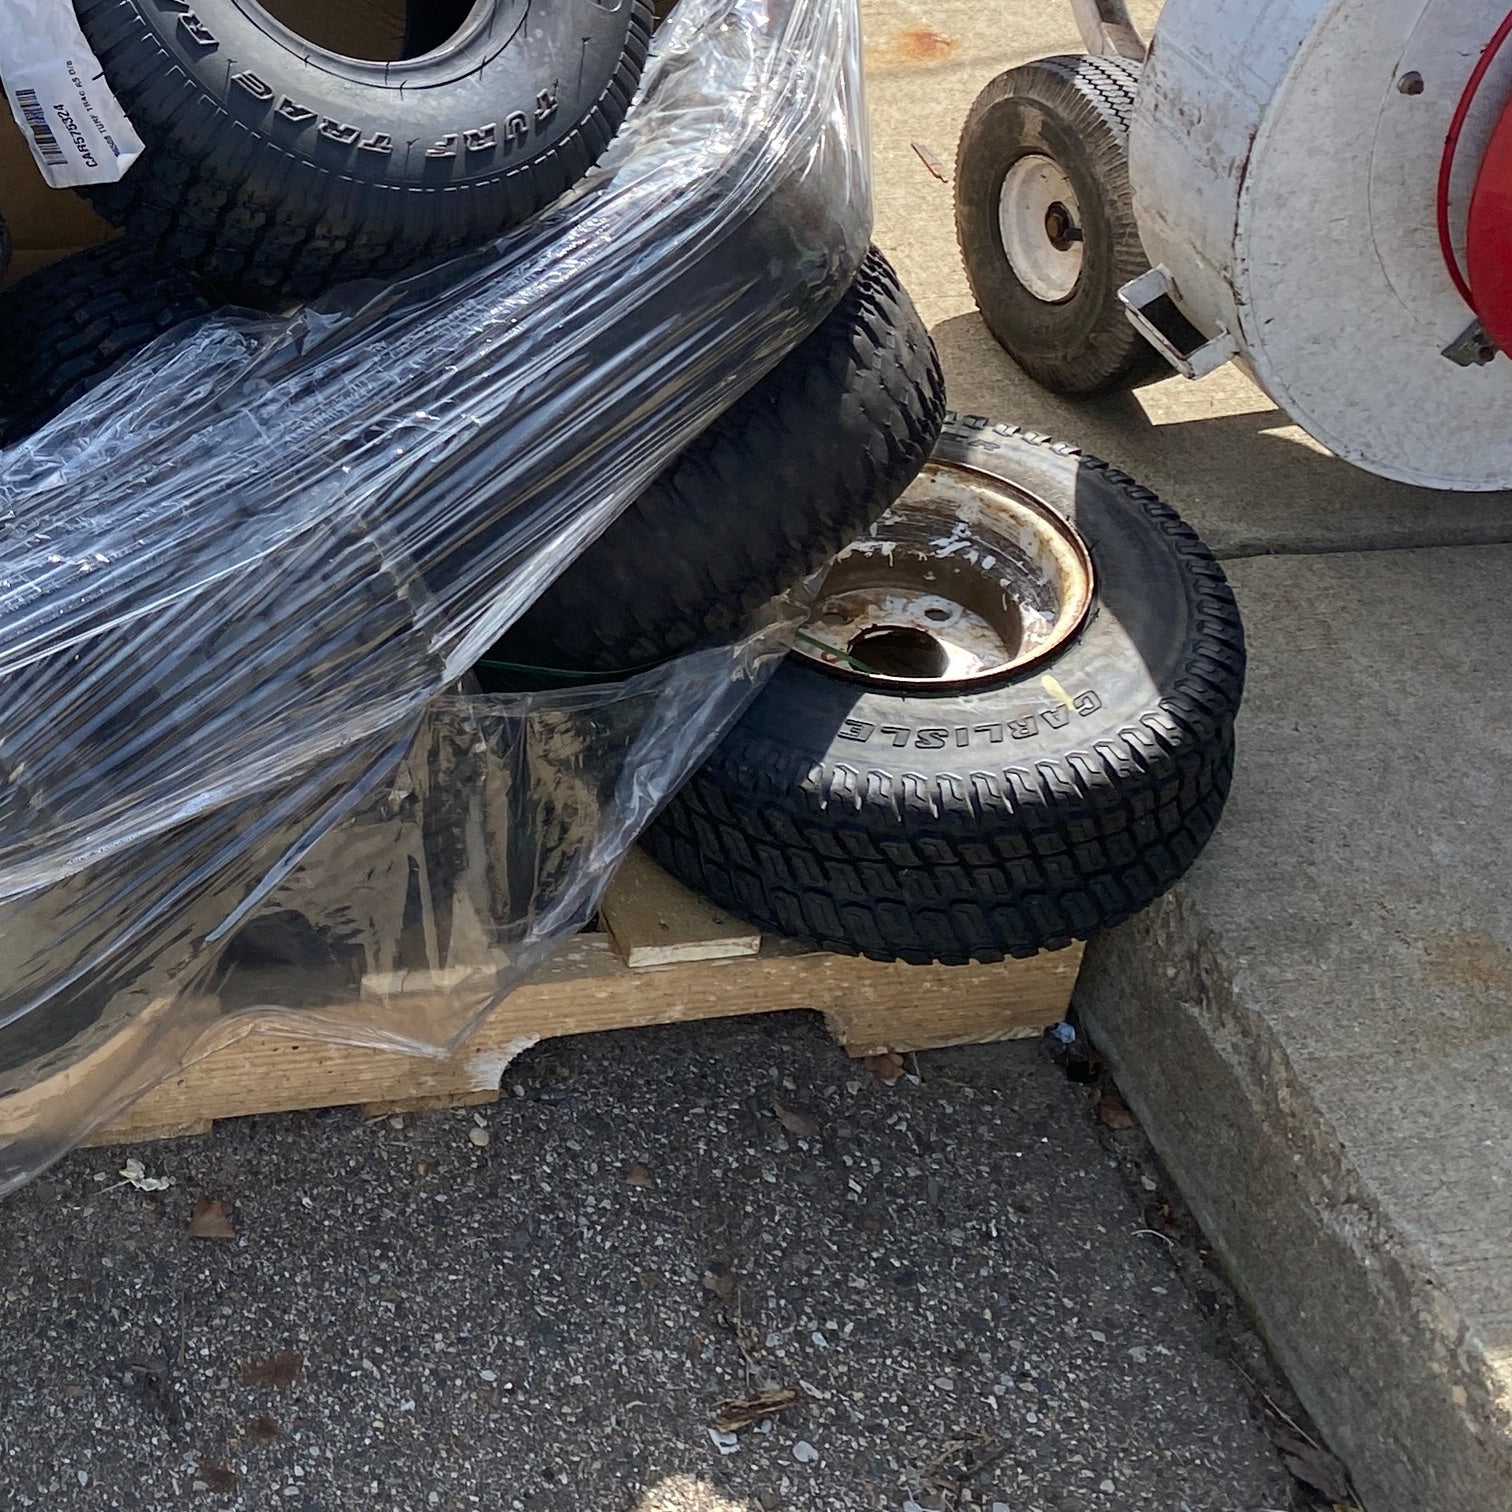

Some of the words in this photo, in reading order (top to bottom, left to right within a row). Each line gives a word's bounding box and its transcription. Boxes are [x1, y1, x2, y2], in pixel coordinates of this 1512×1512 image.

[53, 103, 99, 169] CAR575324
[231, 69, 394, 155] TRAC
[425, 88, 559, 158] TURF
[837, 689, 1103, 750] CARLISLE
